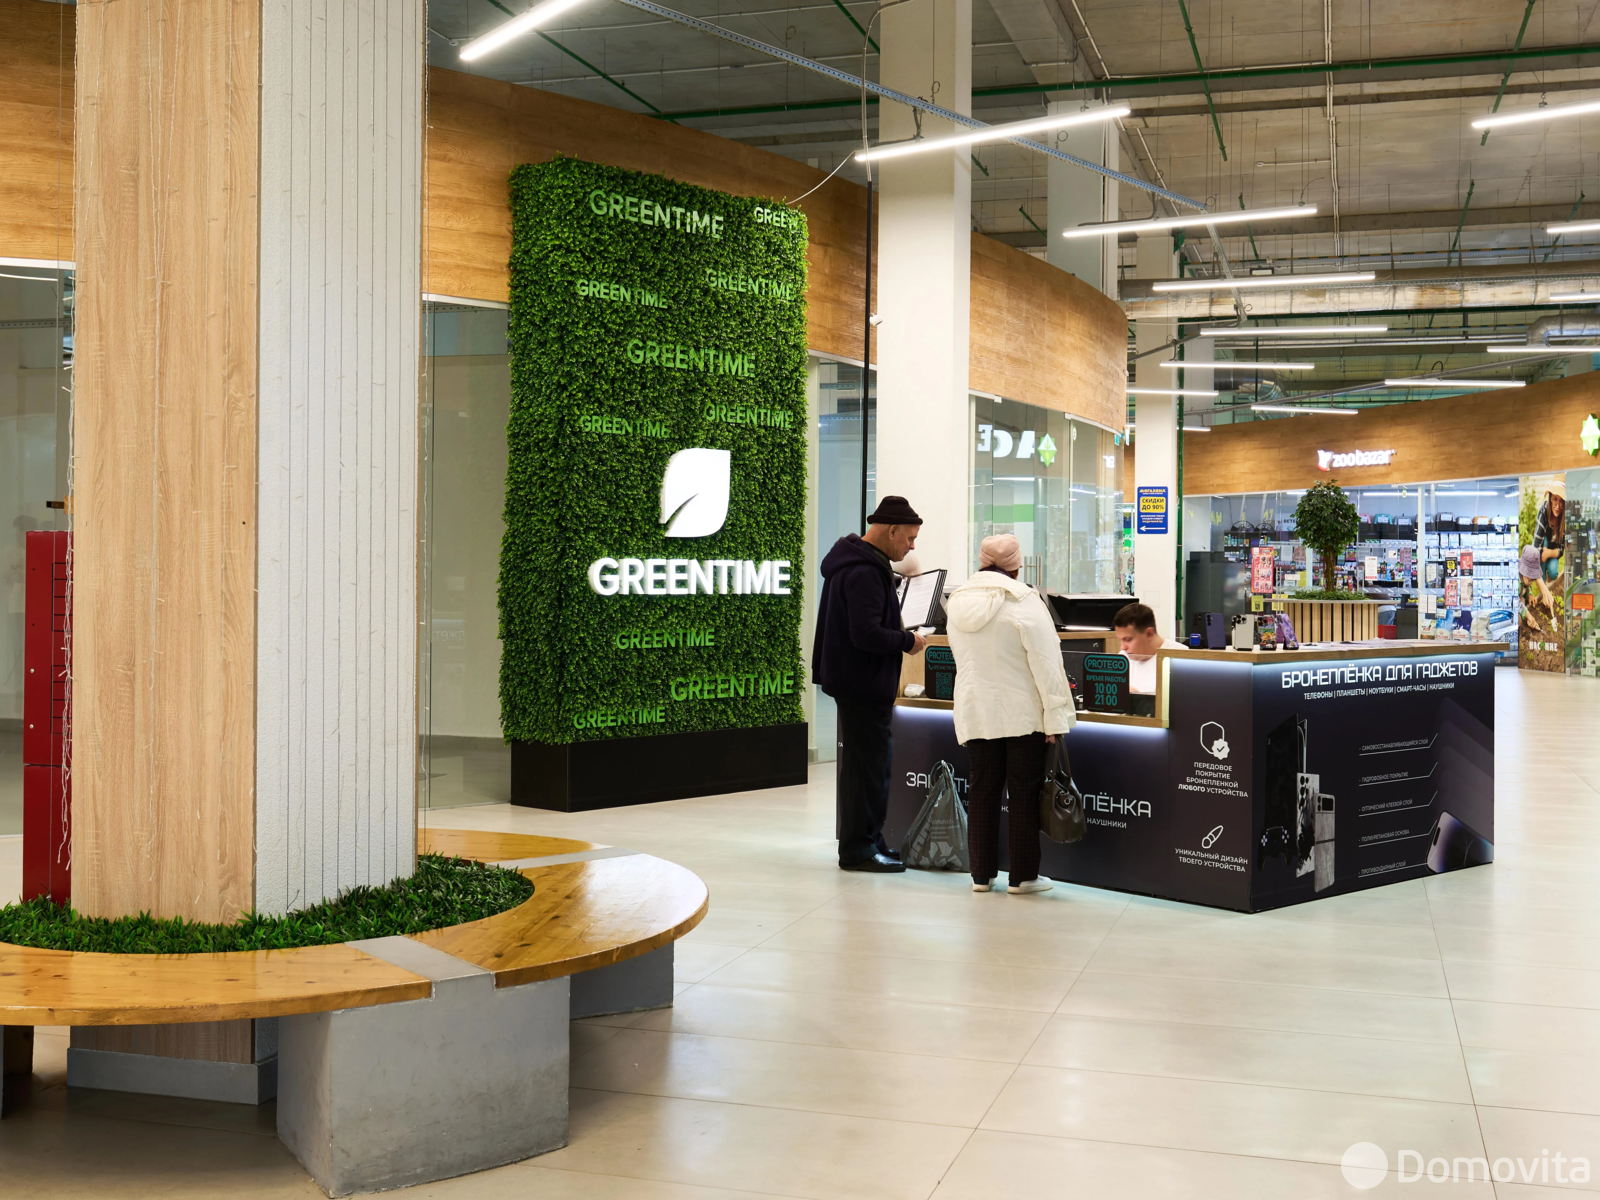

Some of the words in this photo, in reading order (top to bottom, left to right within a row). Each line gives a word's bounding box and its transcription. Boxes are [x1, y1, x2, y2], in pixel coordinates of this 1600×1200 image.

[589, 189, 724, 239] GREENTIME
[706, 268, 796, 301] GREENTIME
[627, 338, 755, 378] GREENTIME
[704, 403, 794, 429] GREENTIME
[580, 415, 670, 438] GREENTIME
[1332, 449, 1392, 468] zoobazar
[587, 557, 791, 596] GREENTIME
[616, 628, 715, 650] GREENTIME
[1087, 659, 1125, 670] PROTEGO
[1281, 664, 1382, 689] БРОНЕПЛЁНКА
[1385, 664, 1413, 681] ДЛЯ
[1416, 661, 1479, 679] ГАДЖЕТОВ
[670, 671, 794, 702] GREENTIME
[1304, 690, 1333, 700] ТЕЛЕФОНЫ
[1336, 688, 1365, 697] ПЛАНШЕТЫ
[1368, 686, 1394, 695] НОУТБУКИ
[1396, 684, 1427, 693] СМАРТ-ЧАСЫ
[1429, 682, 1455, 691] НАУШНИКИ
[573, 706, 666, 729] GREENTIME
[1194, 762, 1233, 772] ПЕРЕДОВОЕ
[1196, 770, 1231, 780] ПОКРЫТИЕ
[1178, 784, 1206, 792] ЛЮБОГО
[1206, 788, 1249, 798] УСТРОЙСТВА
[1186, 776, 1239, 788] БРОНЕПЛЕНКОЙ
[1086, 817, 1127, 829] НАУШНИКИ
[1174, 848, 1220, 860] УНИКАЛЬНЫЙ
[1220, 854, 1248, 864] ДИЗАЙН
[1178, 856, 1203, 866] ТВОЕГО
[1204, 860, 1246, 872] УСТРОЙСТВА
